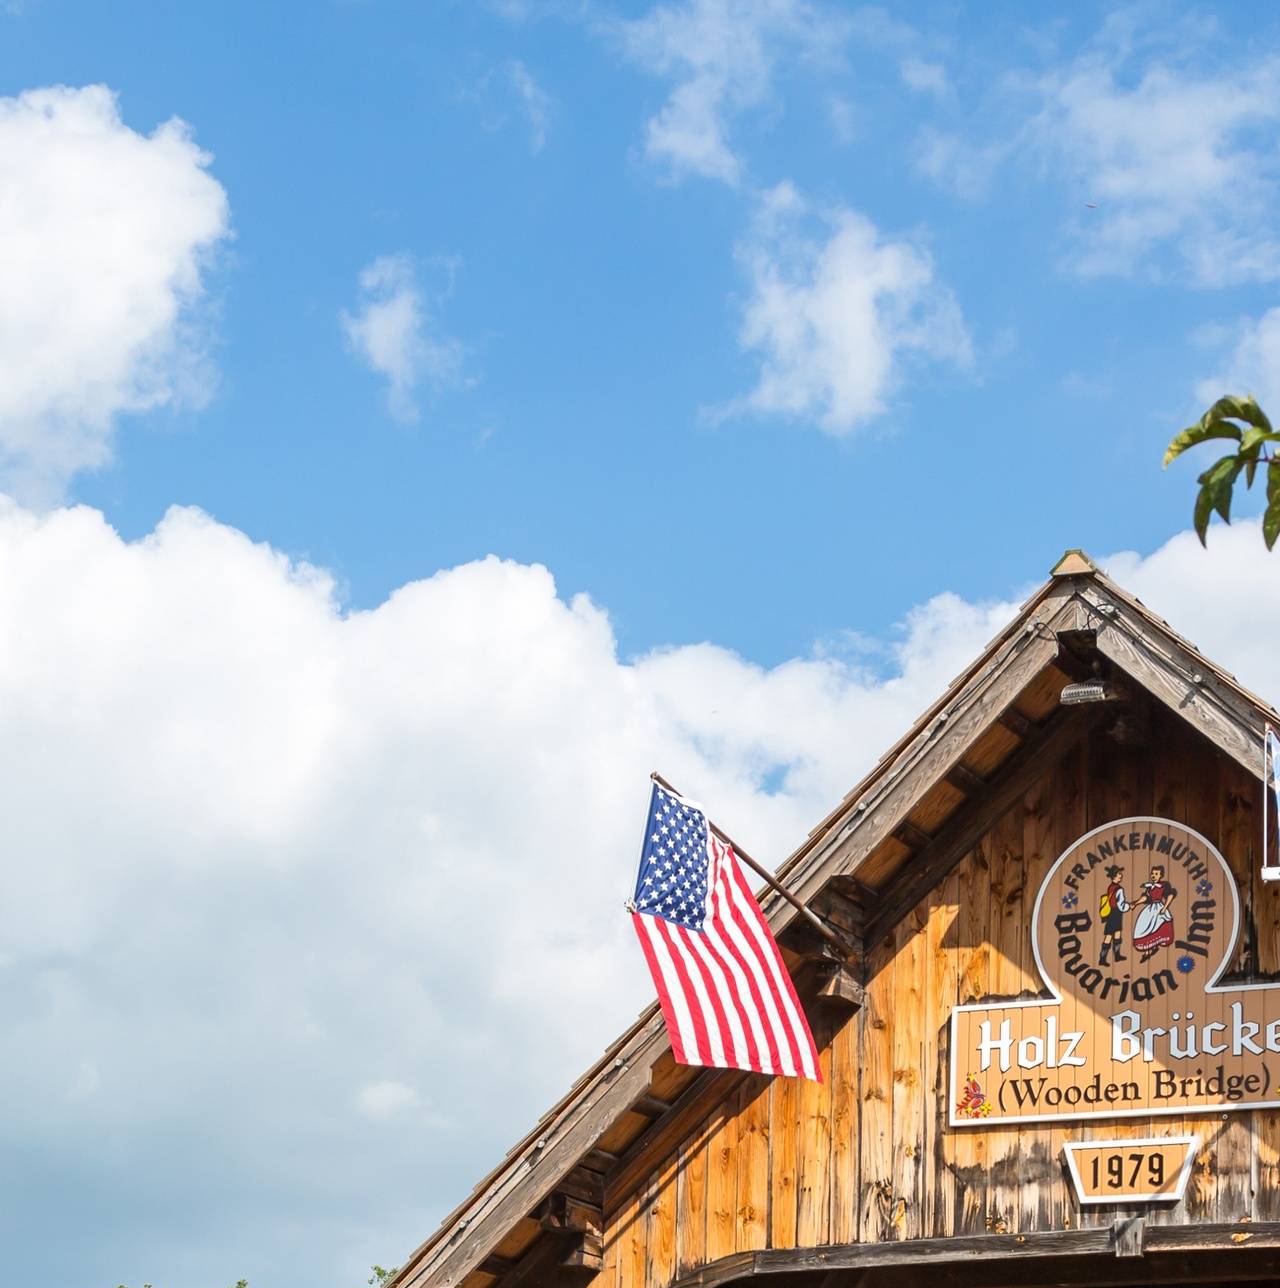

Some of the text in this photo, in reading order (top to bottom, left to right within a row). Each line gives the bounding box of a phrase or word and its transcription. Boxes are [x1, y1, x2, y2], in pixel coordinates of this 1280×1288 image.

[1063, 831, 1209, 892] FRANKENMUTH
[1054, 898, 1217, 1004] Bavarian Inn
[976, 1014, 1087, 1073] Holz
[997, 1062, 1272, 1112] (Wooden Bridge)
[1090, 1151, 1165, 1191] 1979
